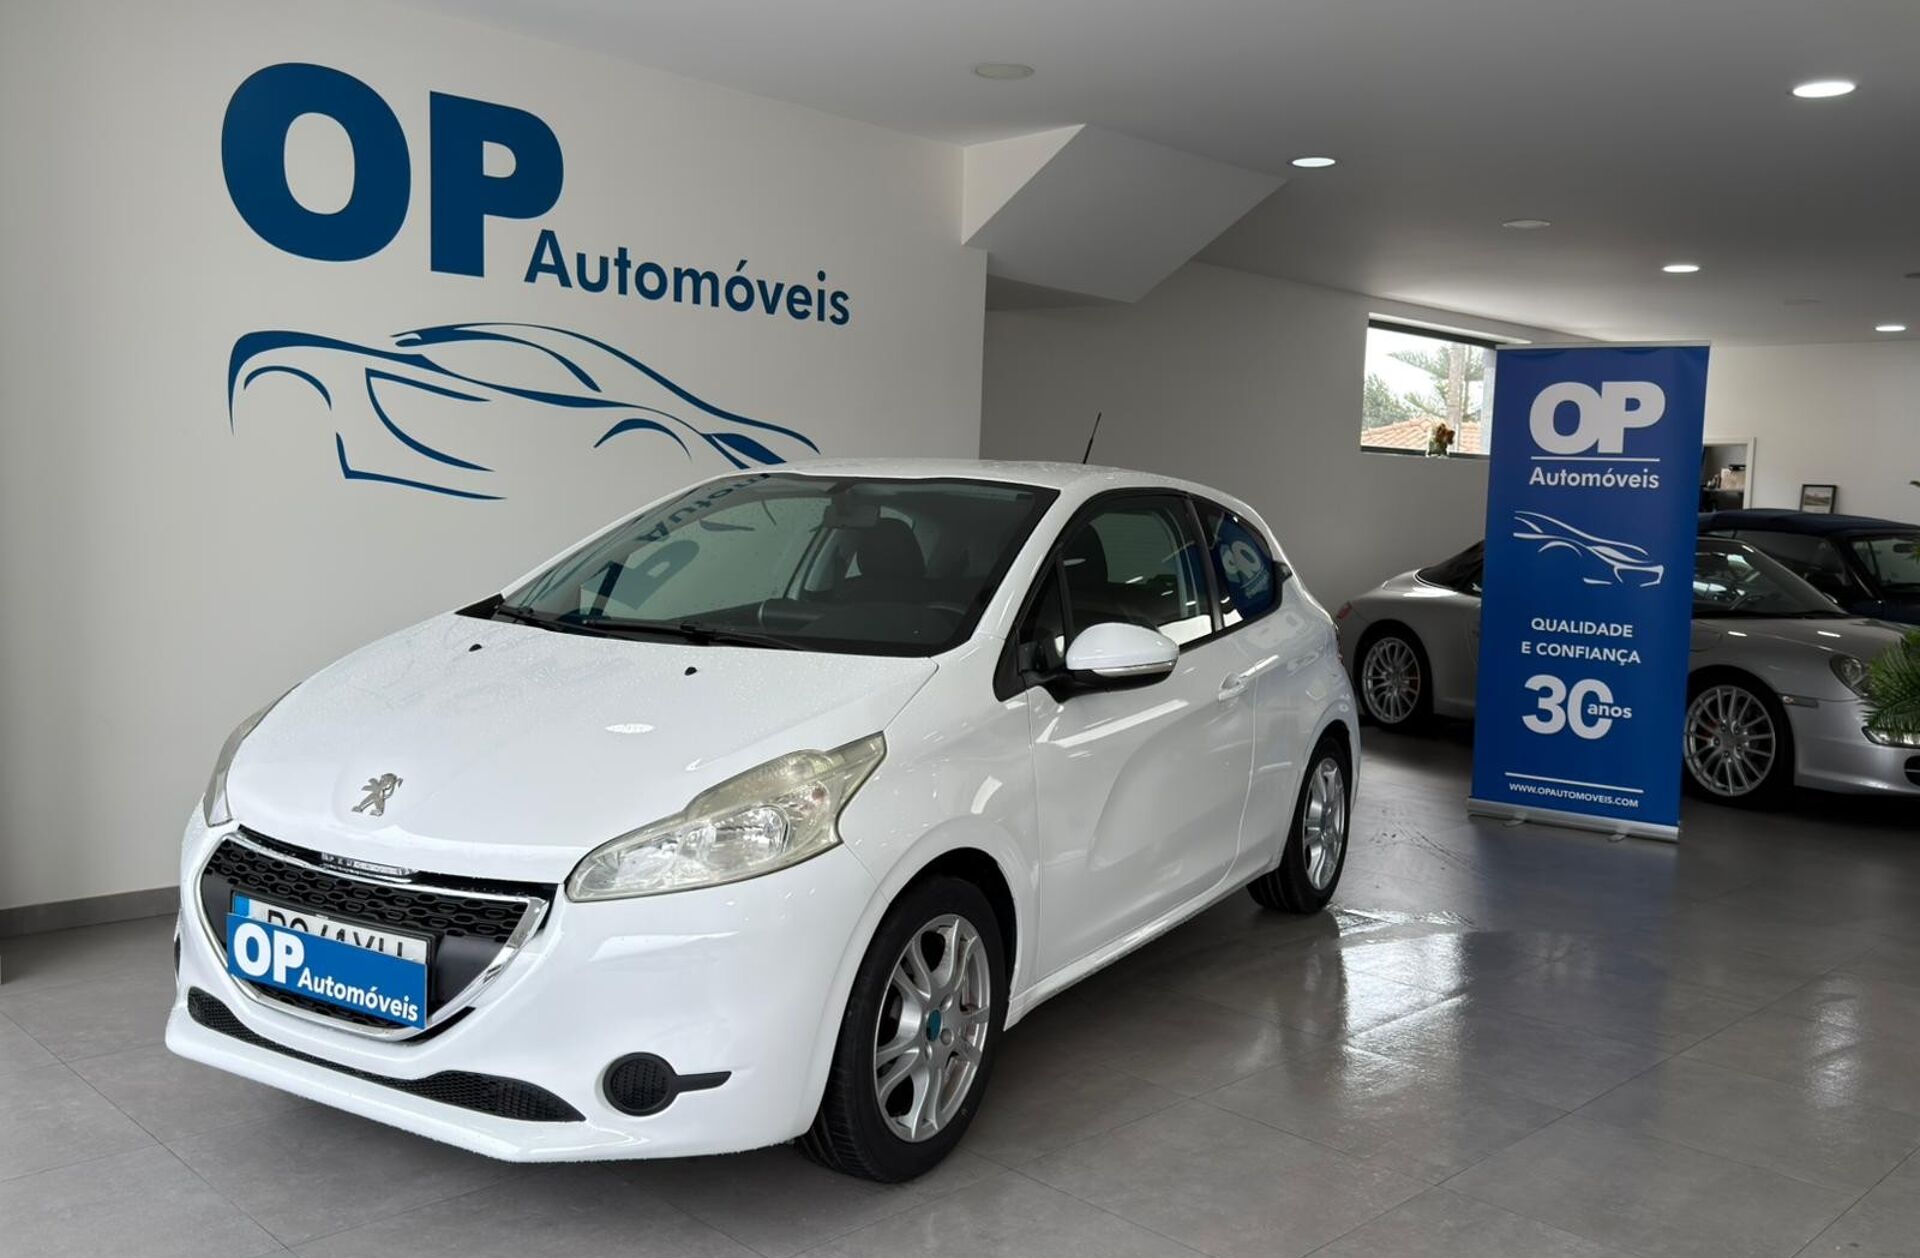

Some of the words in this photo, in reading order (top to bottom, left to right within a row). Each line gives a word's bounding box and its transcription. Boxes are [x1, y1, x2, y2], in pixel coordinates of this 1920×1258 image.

[222, 62, 564, 278] OP
[524, 229, 850, 326] Automóveis
[1529, 380, 1666, 455] OP
[1529, 466, 1660, 489] Automóveis
[1521, 641, 1531, 654] E
[1536, 642, 1641, 666] CONFIANÇA
[1531, 617, 1633, 638] QUALIDADE
[1522, 674, 1614, 740] 30
[1587, 703, 1633, 720] anos
[1509, 782, 1639, 808] WWW.OPAUTOMOVEIS.COM
[233, 922, 305, 985] OP
[297, 966, 419, 1022] Automóveis
